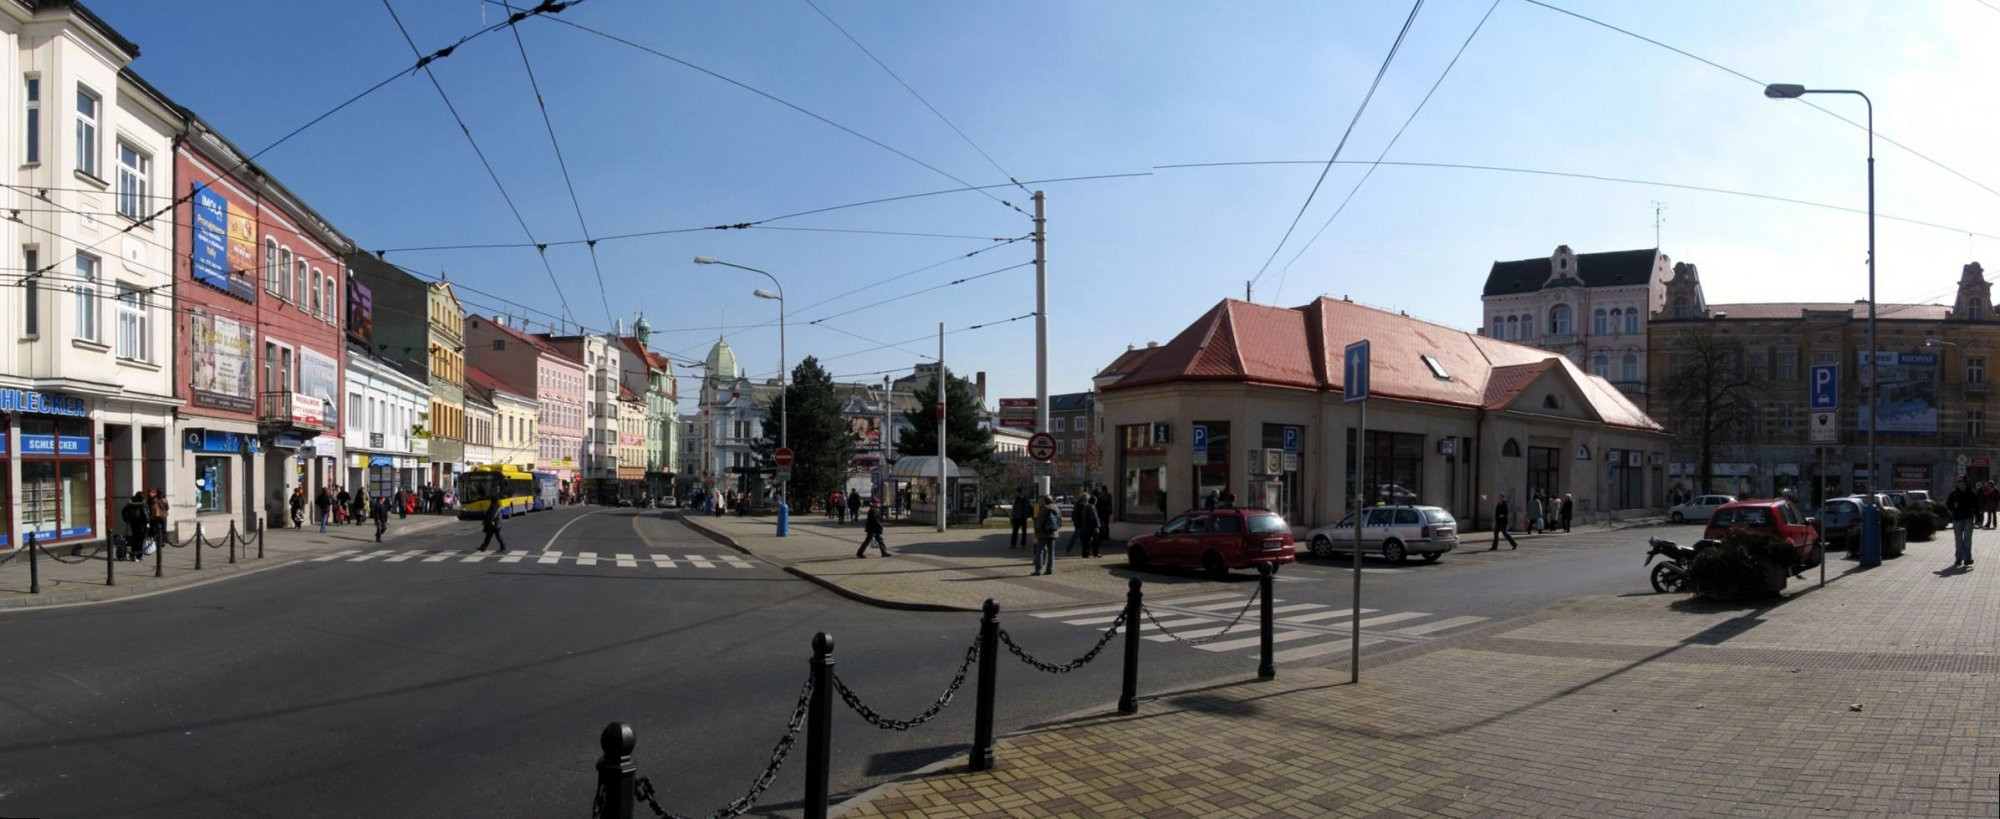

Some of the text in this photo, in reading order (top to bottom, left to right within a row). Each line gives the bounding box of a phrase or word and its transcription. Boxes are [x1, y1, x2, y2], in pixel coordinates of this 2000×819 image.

[202, 195, 222, 217] IMOLA
[1817, 369, 1831, 393] P
[1196, 429, 1204, 444] P
[1287, 430, 1295, 444] P
[29, 440, 77, 450] SCHLECKER
